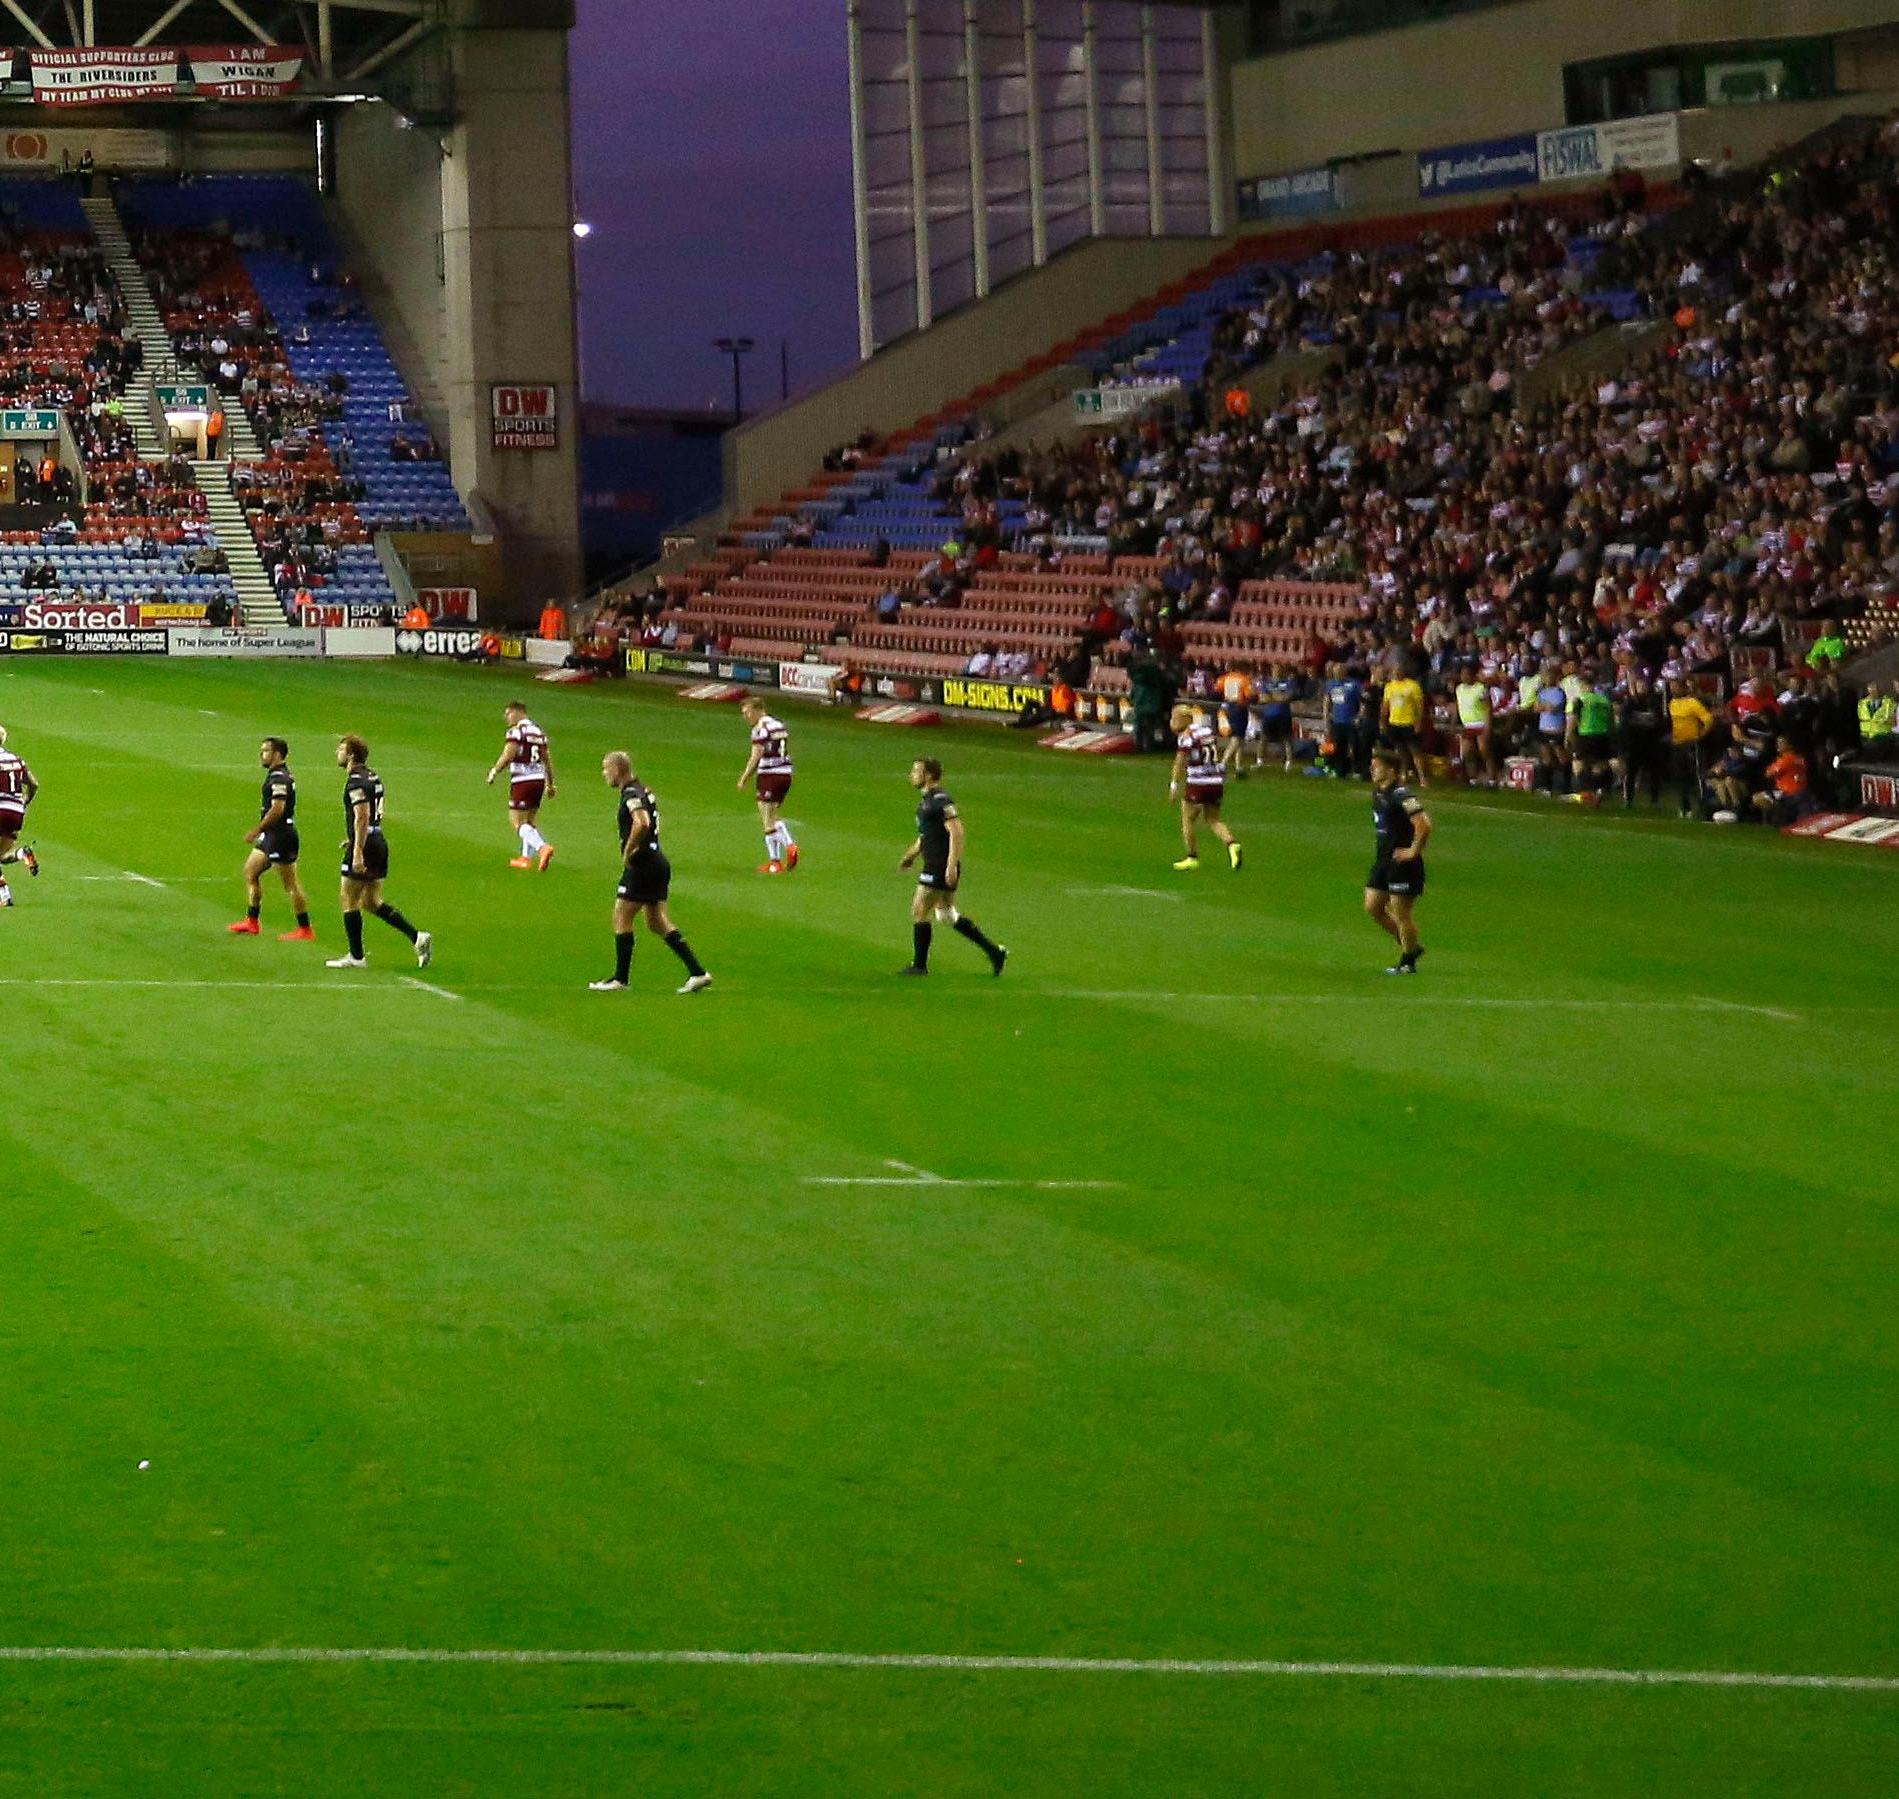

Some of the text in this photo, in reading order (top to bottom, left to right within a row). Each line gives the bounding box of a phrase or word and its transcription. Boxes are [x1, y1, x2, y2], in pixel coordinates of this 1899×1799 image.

[32, 50, 146, 64] OFFICIAL SUPPORTERS
[51, 70, 158, 83] THE RIVERSIDERS
[221, 66, 274, 77] WIGAN
[171, 396, 190, 405] EXIT
[500, 388, 547, 416] DW
[21, 421, 40, 430] EXIT
[495, 418, 555, 431] SPORTS
[495, 434, 555, 447] FITNESS
[24, 604, 137, 630] Sorted.
[64, 632, 166, 642] THE NATURAL CHOICE
[176, 638, 315, 650] The Super League
